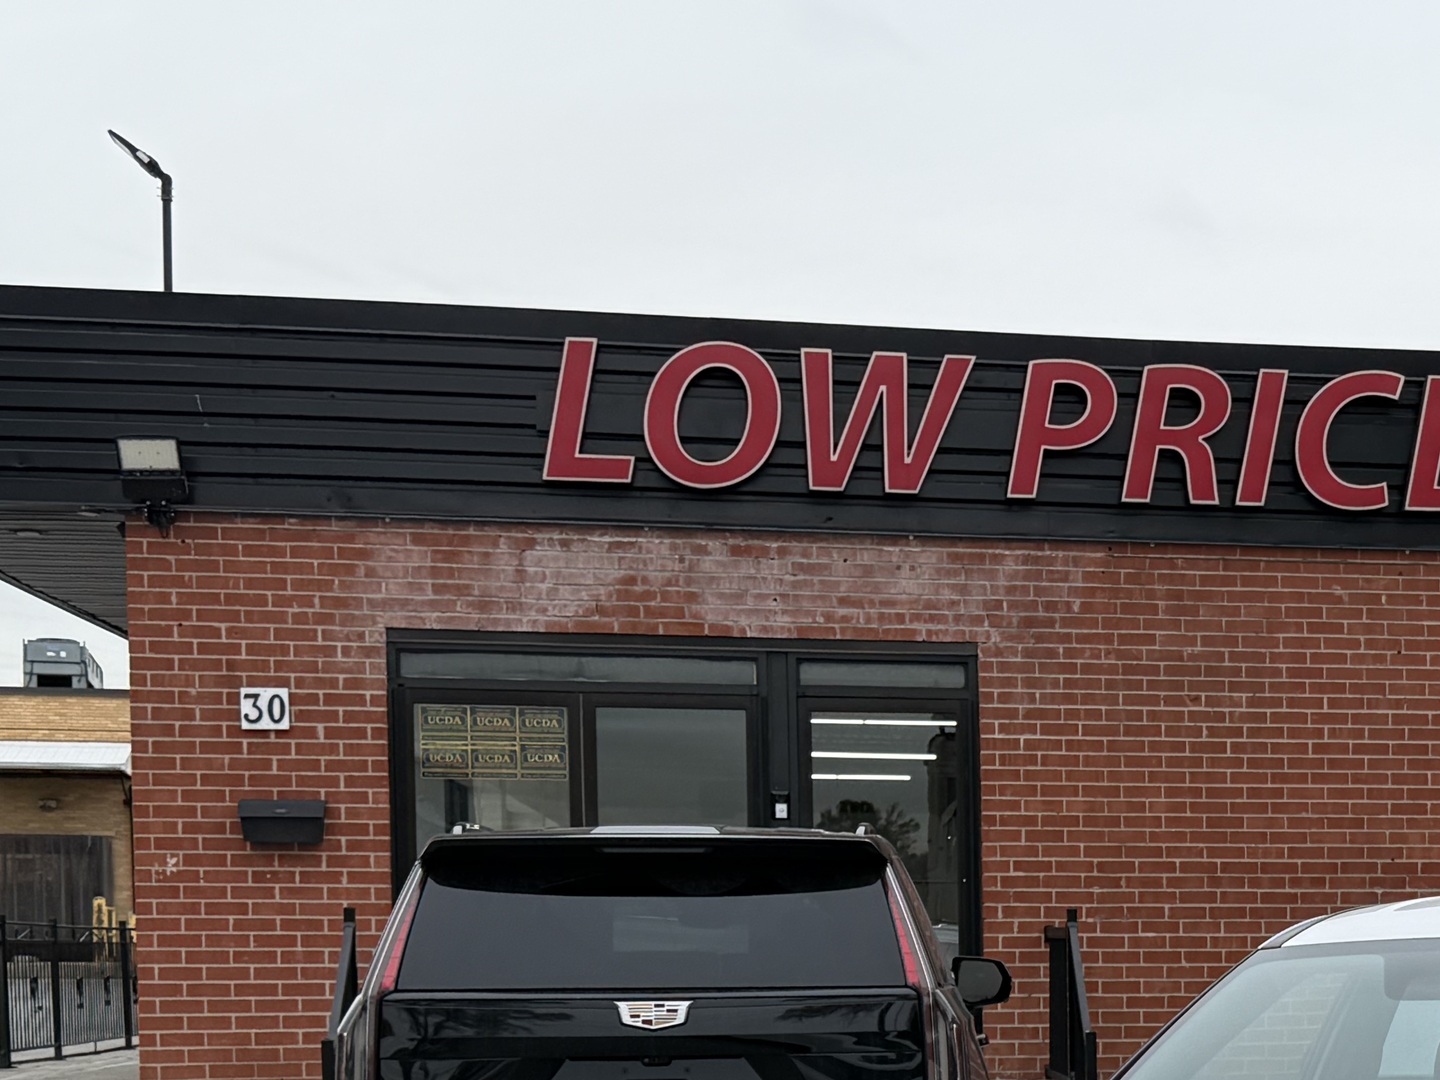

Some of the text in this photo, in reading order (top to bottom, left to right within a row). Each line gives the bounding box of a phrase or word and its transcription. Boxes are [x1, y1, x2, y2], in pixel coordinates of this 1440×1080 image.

[541, 336, 977, 491] LOW
[243, 692, 286, 725] 30
[427, 715, 462, 726] UCDA
[476, 716, 511, 727] UCDA
[525, 718, 559, 729] UCDA
[429, 753, 463, 763] UCDA
[478, 753, 511, 764] UCDA
[526, 753, 561, 764] UCDA
